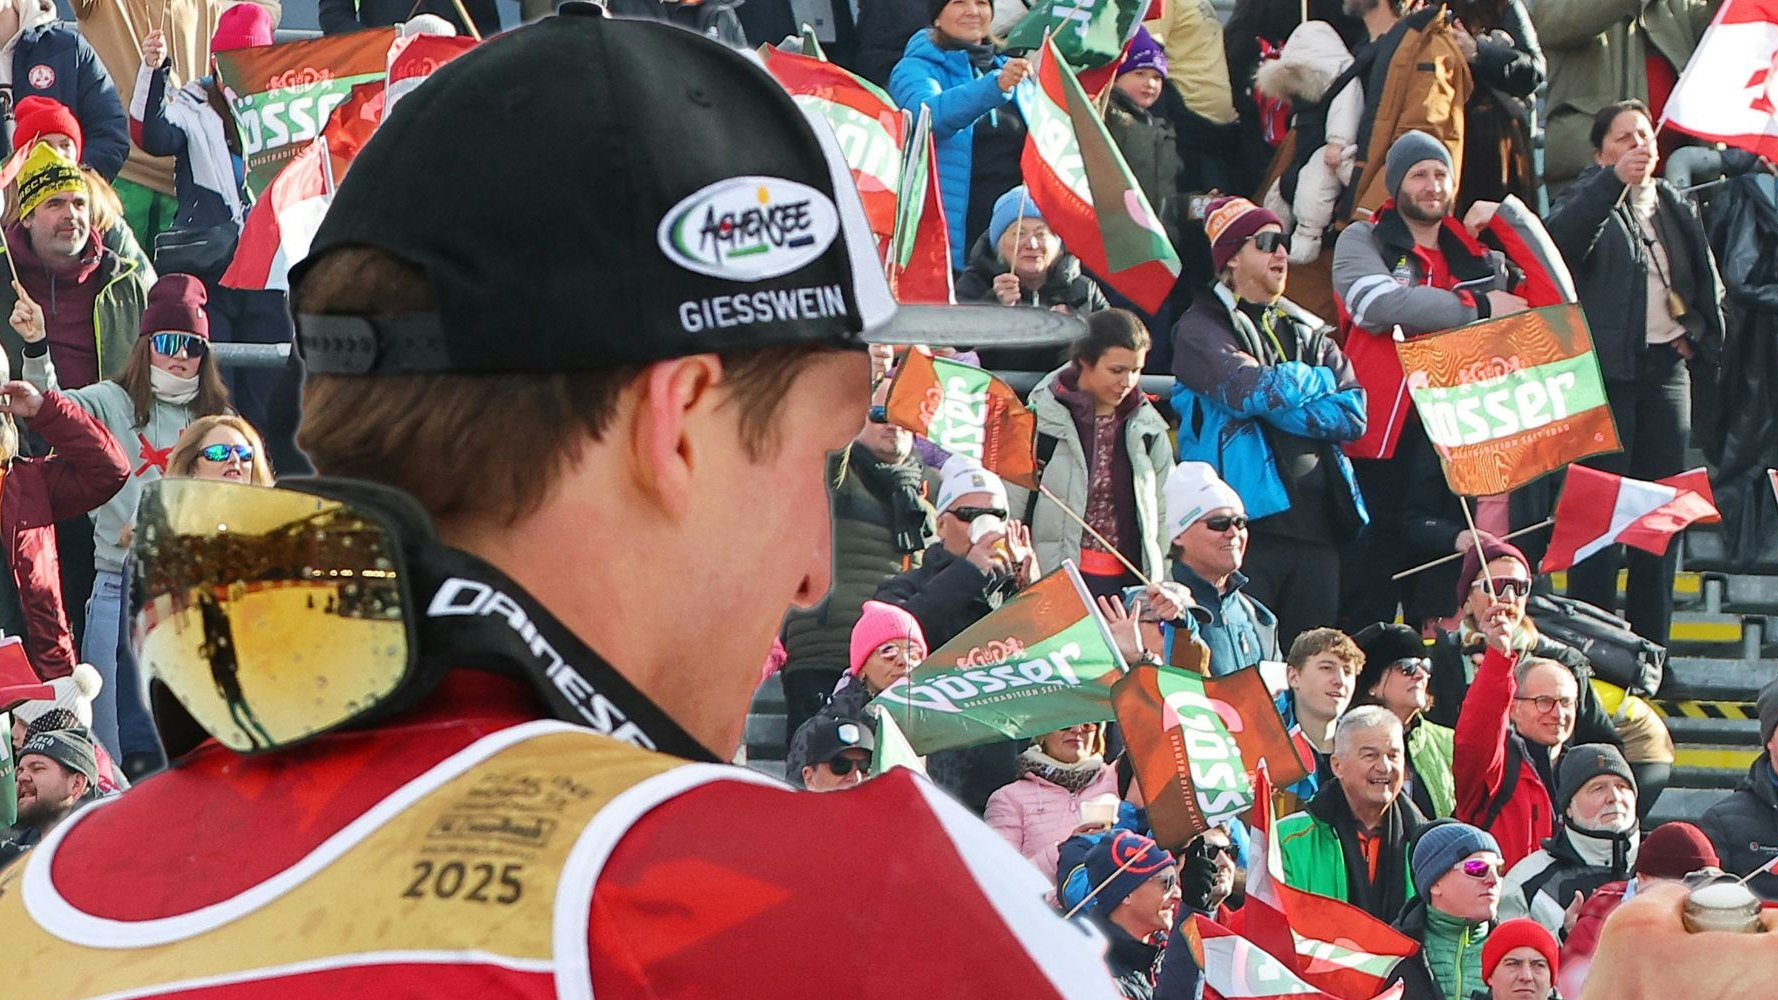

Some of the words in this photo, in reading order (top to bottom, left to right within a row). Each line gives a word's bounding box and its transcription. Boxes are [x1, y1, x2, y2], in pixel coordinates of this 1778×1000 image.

[700, 199, 812, 266] ACHENSEE
[678, 284, 848, 333] GIESSWEIN
[880, 642, 1082, 714] Gösser
[402, 860, 524, 905] 2025
